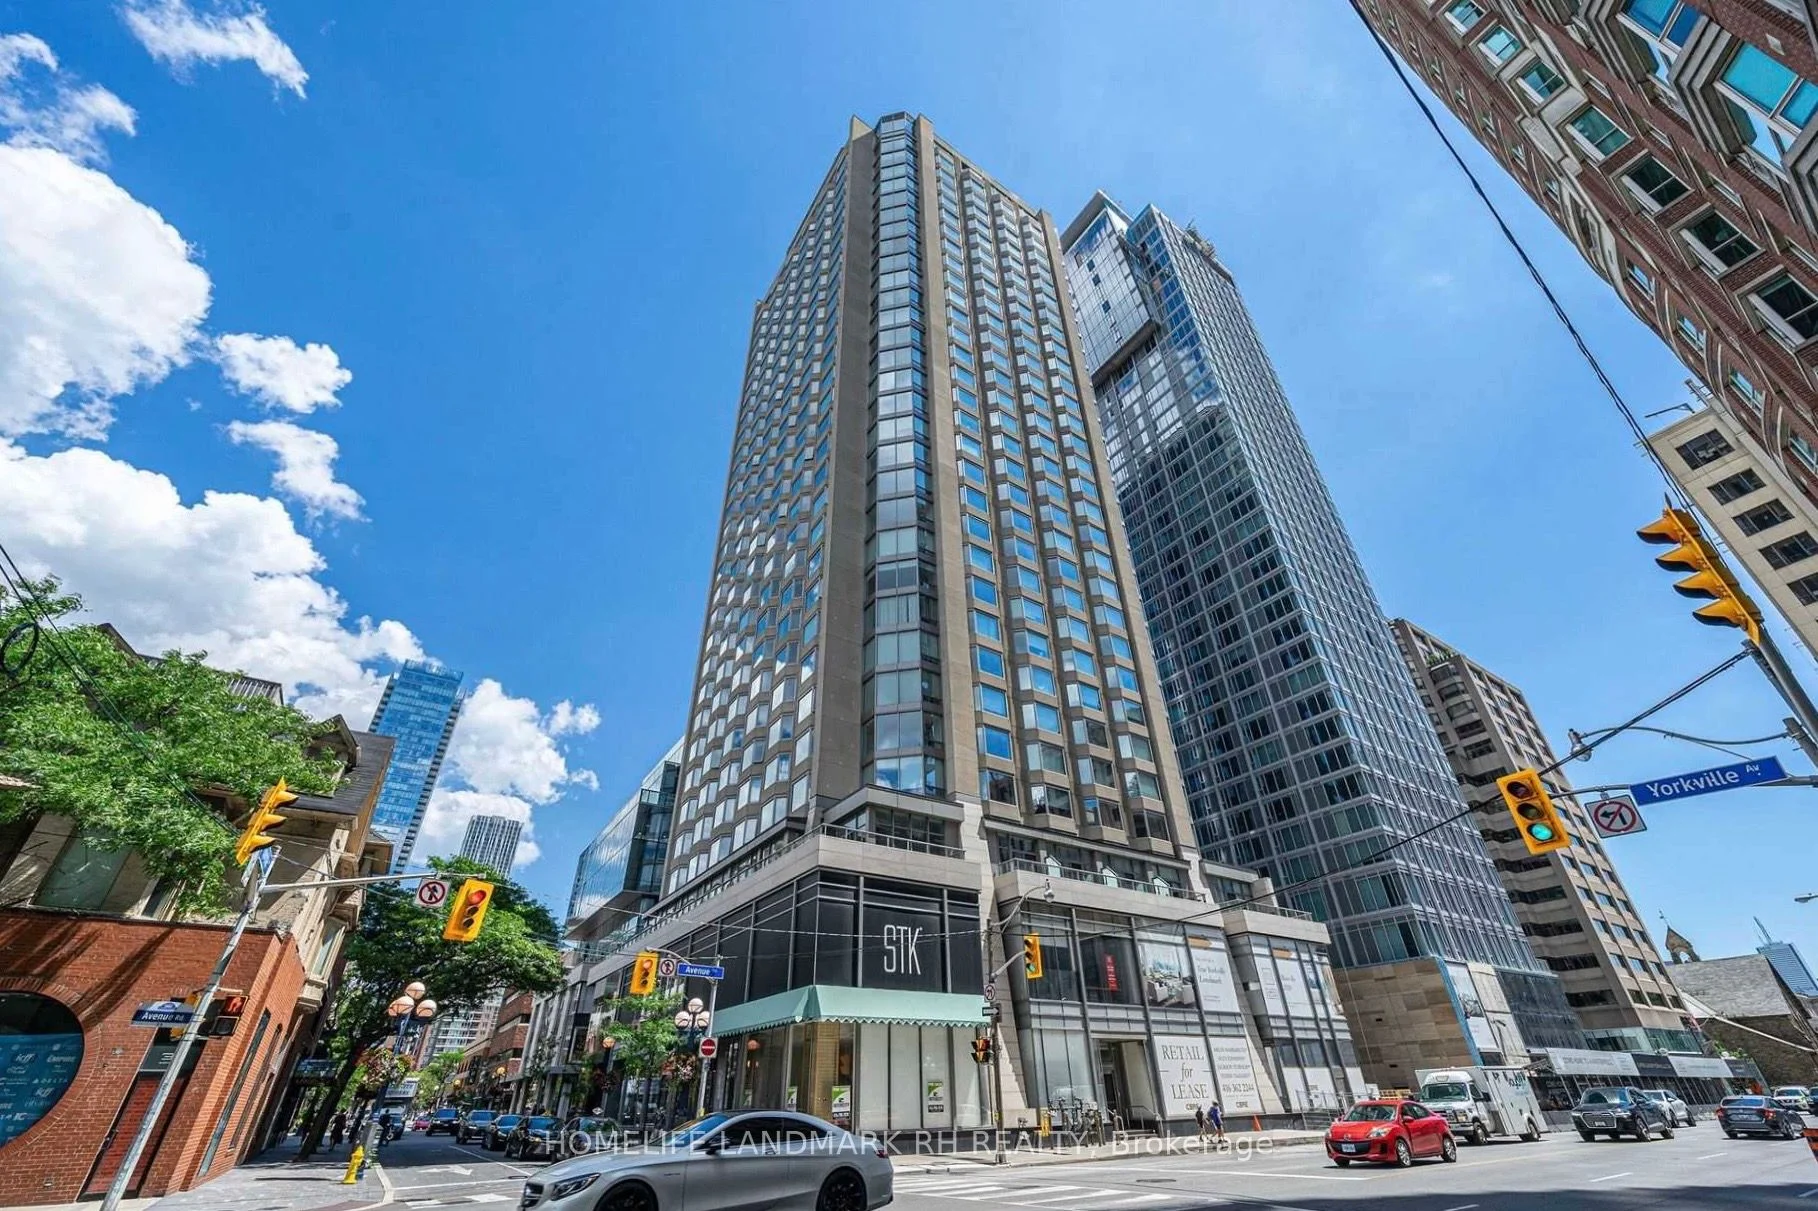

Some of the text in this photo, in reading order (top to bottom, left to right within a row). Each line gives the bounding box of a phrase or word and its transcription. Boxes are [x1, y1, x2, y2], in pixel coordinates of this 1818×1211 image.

[1646, 770, 1740, 798] Yorkville
[883, 924, 921, 975] STK
[685, 965, 711, 976] Avenue
[141, 1011, 174, 1021] Avenue
[1161, 1044, 1205, 1061] RETAIL
[1180, 1062, 1193, 1082] for
[1170, 1083, 1209, 1100] LEASE
